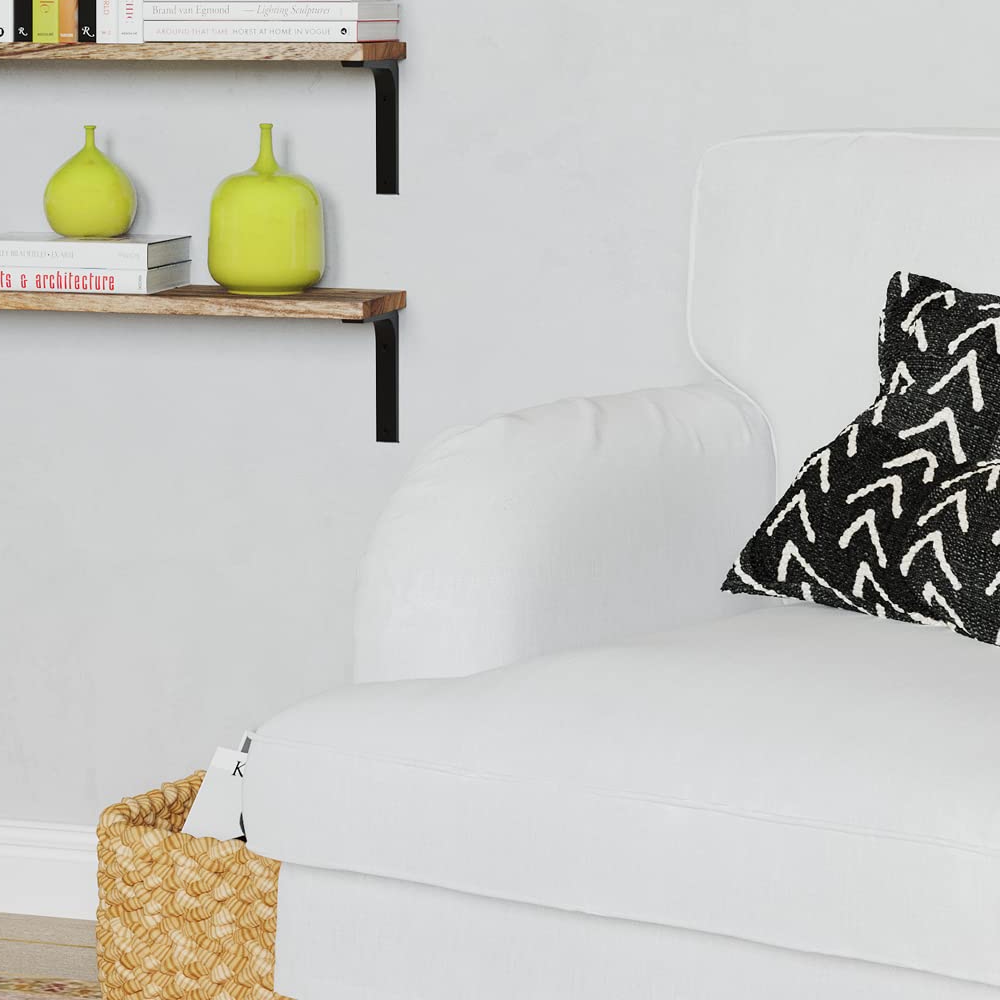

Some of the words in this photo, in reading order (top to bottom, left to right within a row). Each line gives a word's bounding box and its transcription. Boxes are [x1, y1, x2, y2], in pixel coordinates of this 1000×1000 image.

[152, 5, 176, 15] Brand
[180, 7, 193, 15] van
[196, 5, 230, 17] Egmond
[256, 4, 289, 18] Lighting
[290, 3, 330, 17] Sculptures
[20, 272, 28, 289] &
[35, 271, 115, 291] architecture
